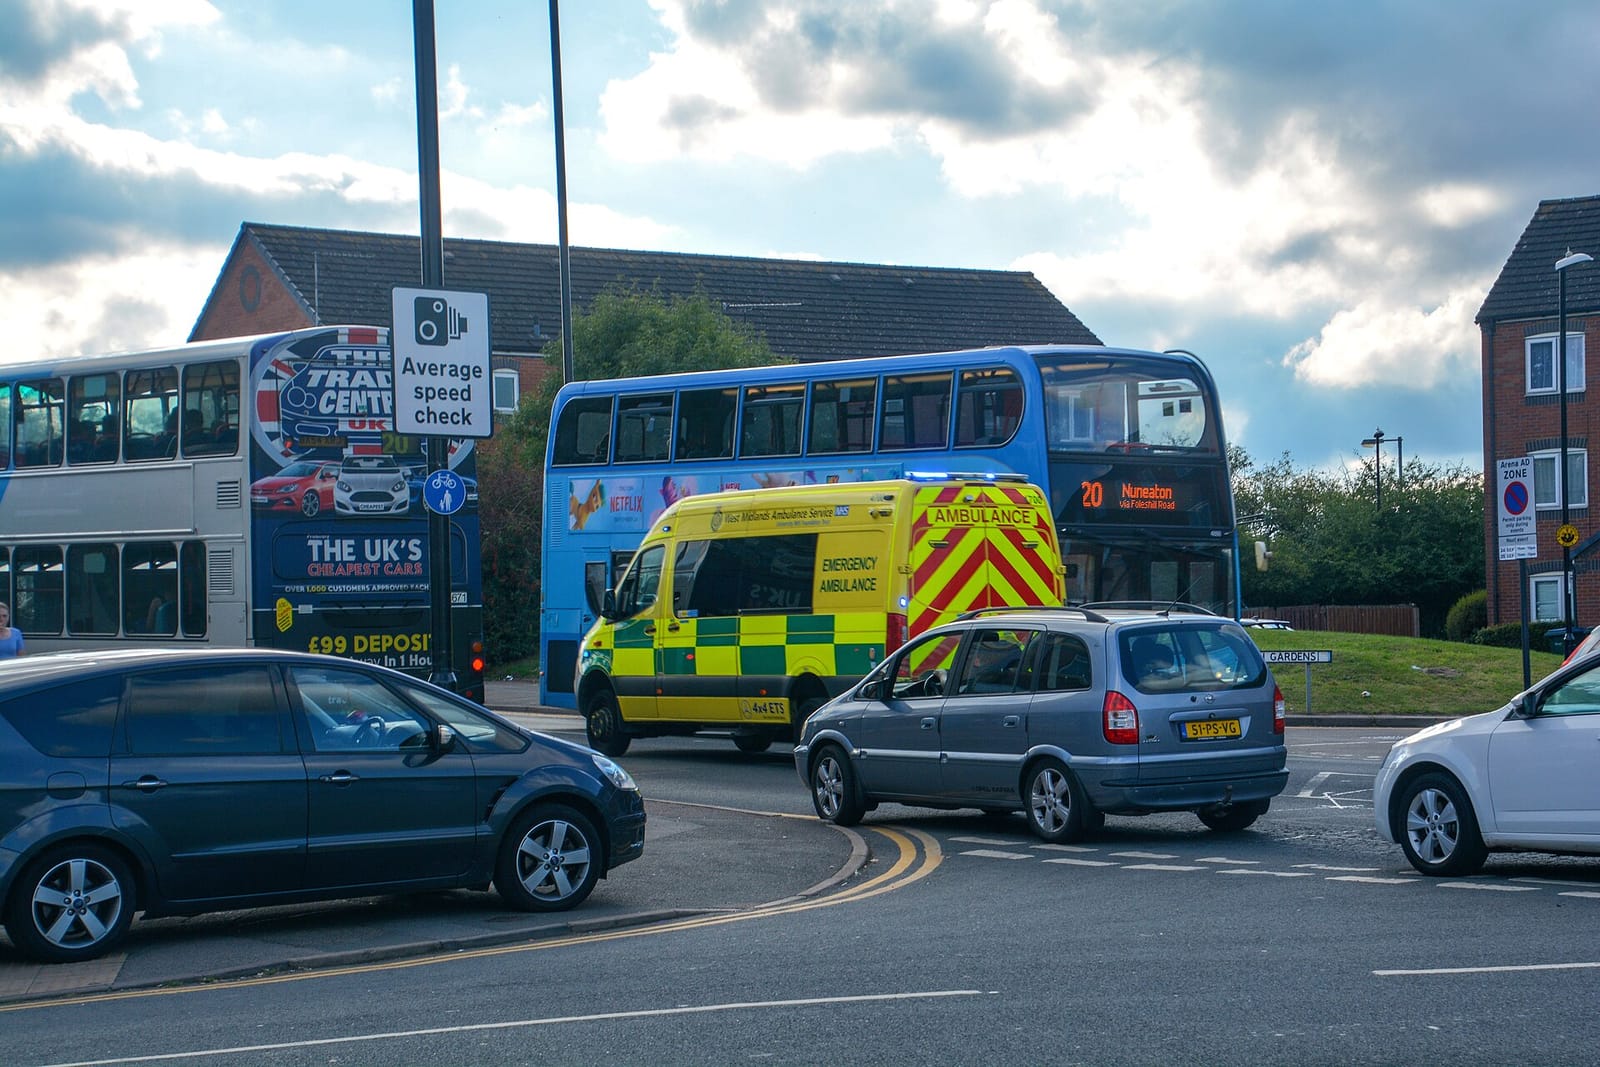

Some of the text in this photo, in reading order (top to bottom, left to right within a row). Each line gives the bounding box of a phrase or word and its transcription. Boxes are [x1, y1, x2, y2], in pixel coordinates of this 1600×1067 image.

[402, 357, 482, 382] Average
[414, 384, 471, 403] speed
[415, 406, 472, 425] check
[348, 419, 387, 430] UK
[1500, 461, 1519, 469] Arena
[1503, 468, 1528, 480] ZONE
[1081, 480, 1104, 508] 20
[1121, 483, 1173, 499] Nuneaton
[610, 495, 643, 513] NETFLIX
[1119, 499, 1130, 509] via
[1158, 500, 1176, 511] Road
[725, 506, 849, 523] West Midlands Ambulance Service NHS
[935, 508, 1031, 525] AMBULANCE
[307, 538, 422, 561] THE UK'S
[307, 562, 423, 577] CHEAPEST CARS
[822, 556, 878, 572] EMERGENCY
[285, 585, 305, 593] OVER
[328, 584, 370, 593] CUSTOMERS
[372, 583, 409, 592] APPROVED
[820, 577, 877, 593] AMBULANCE
[308, 633, 432, 654] £99 DEPOSI
[384, 655, 397, 667] In
[400, 655, 406, 666] 1
[1269, 652, 1317, 661] GARDENS
[752, 701, 785, 714] 4x4 ETS
[1191, 723, 1237, 736] 51-PS-VG
